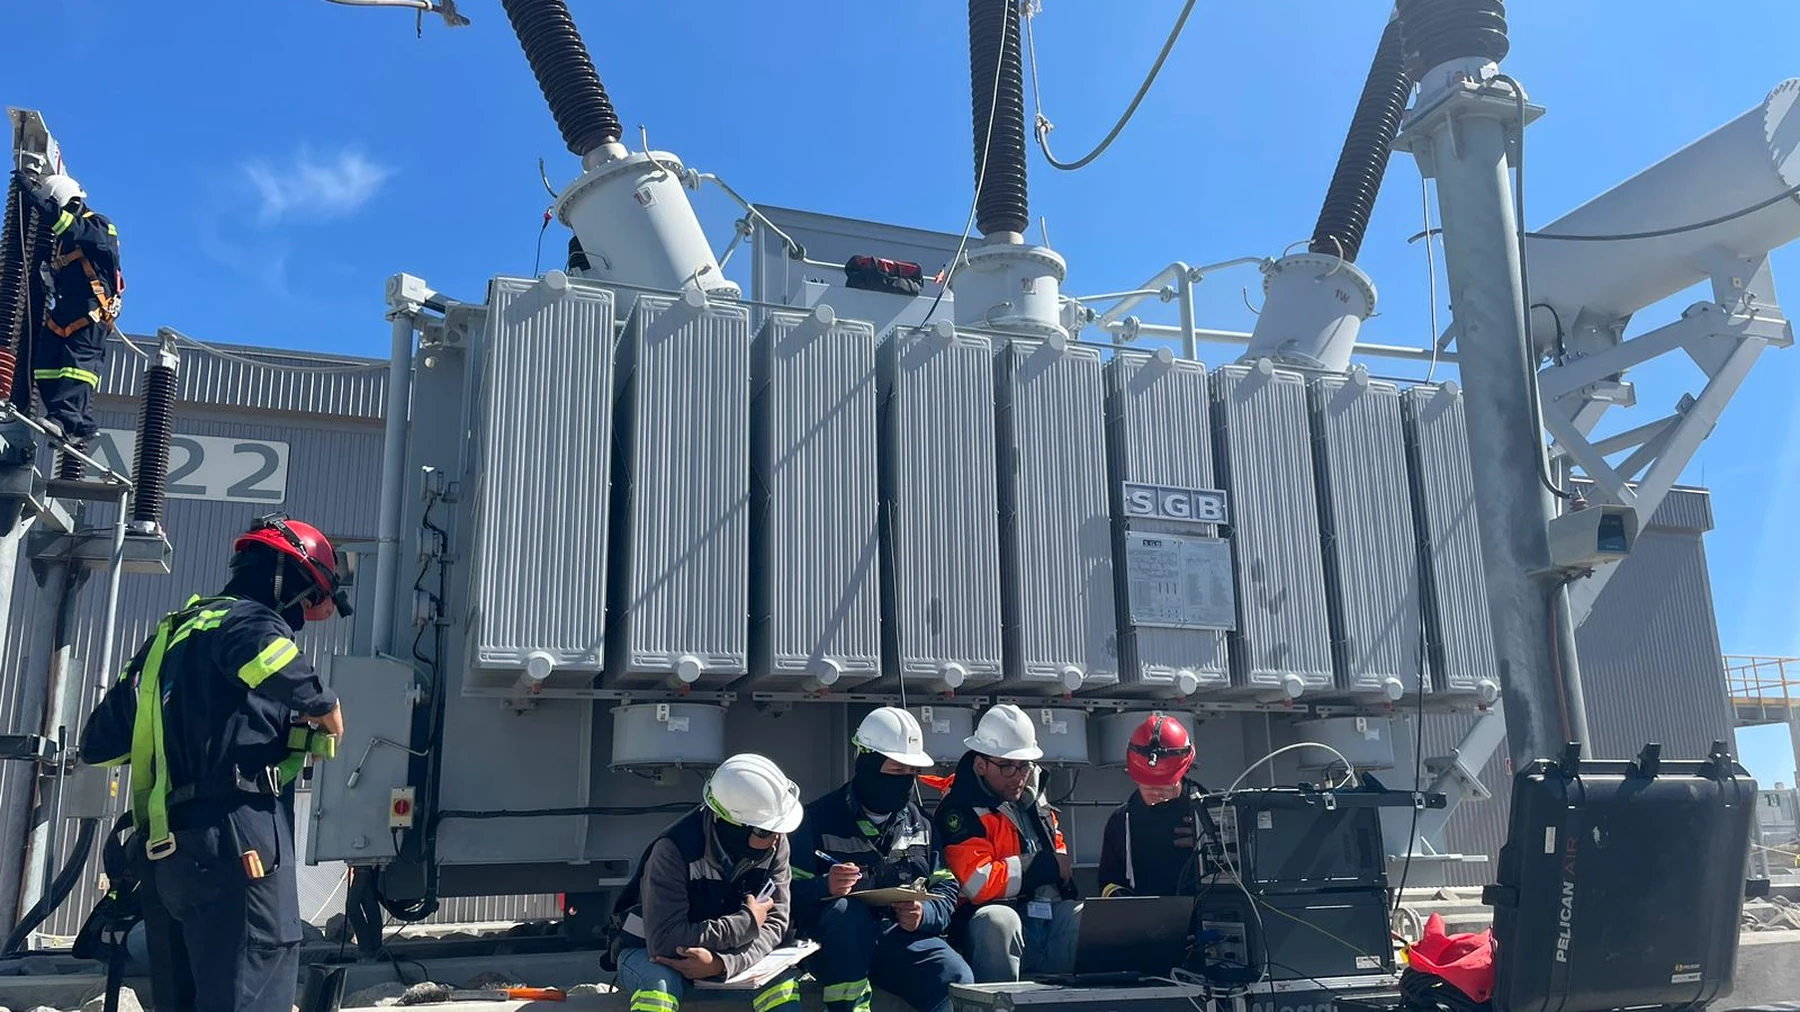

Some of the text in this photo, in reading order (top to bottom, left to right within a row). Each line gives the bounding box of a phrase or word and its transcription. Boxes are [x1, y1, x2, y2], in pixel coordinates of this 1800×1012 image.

[1130, 491, 1222, 520] SGB
[1556, 837, 1579, 963] PELICAN AIR
